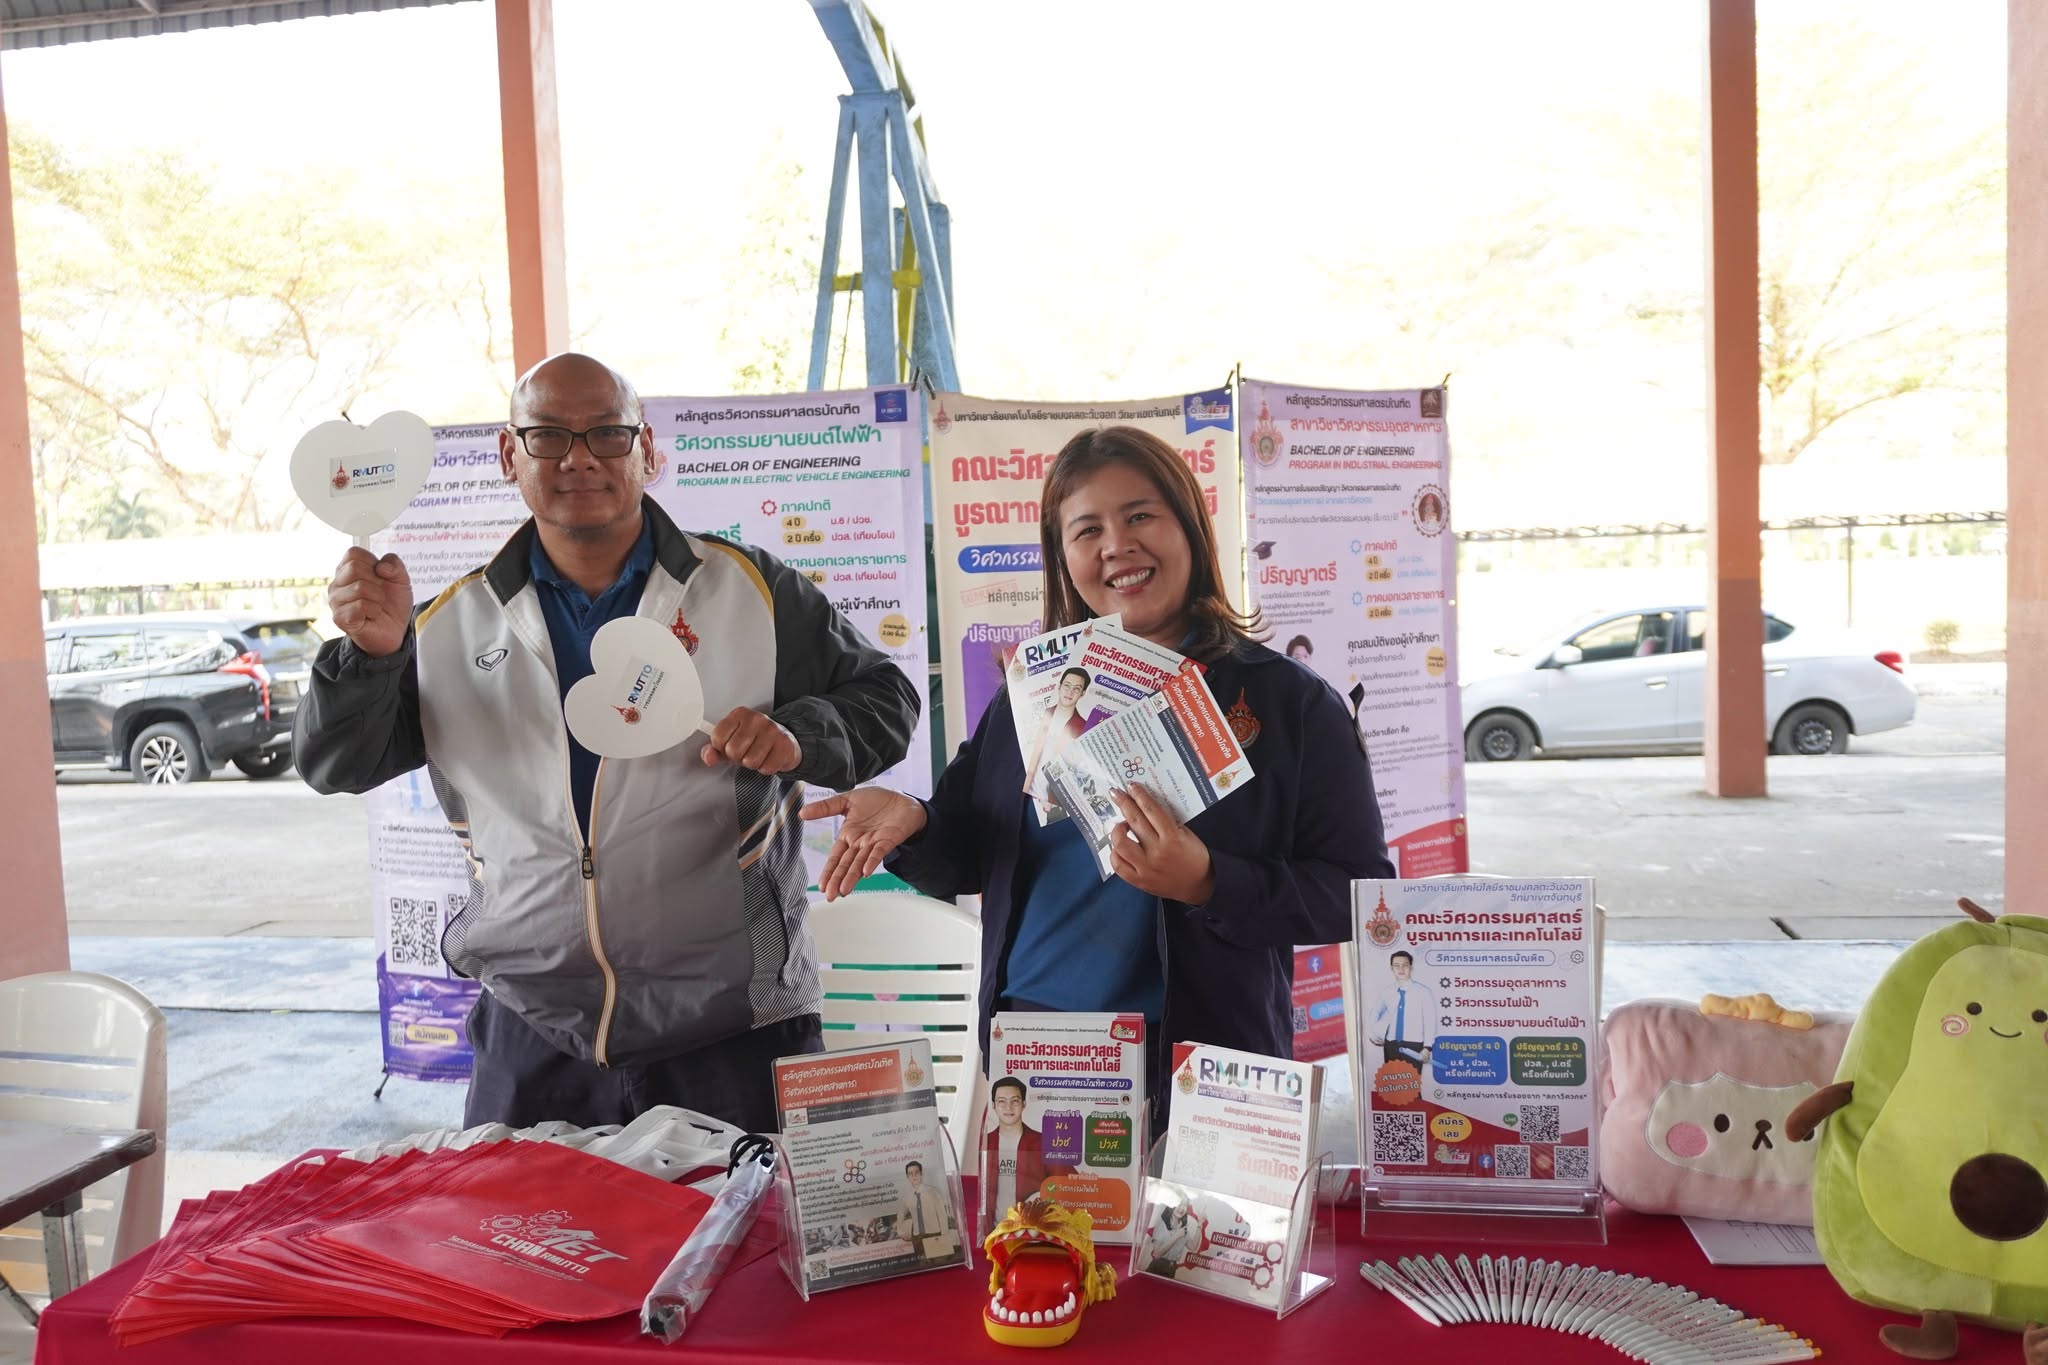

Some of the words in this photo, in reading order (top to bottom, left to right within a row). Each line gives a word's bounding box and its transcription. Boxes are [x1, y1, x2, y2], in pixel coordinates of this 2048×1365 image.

[675, 403, 860, 425] หลักสูตรวิศวกรรมศาสตรบัณฑิต
[954, 408, 1117, 422] มหาวิทยาลัยเทคโนโลยีราชมงคลตะวันออก
[1290, 417, 1442, 437] สาขาวิชาวิศวกรรมอุตสาหการ
[675, 423, 882, 452] วิศวกรรมยานยนต์ไฟฟ้า
[1290, 445, 1341, 456] BACHELOR
[1343, 445, 1357, 456] OF
[1357, 446, 1416, 456] ENGINEERING
[352, 463, 395, 478] RMUTTO
[677, 460, 749, 474] BACHELOR
[752, 460, 771, 471] OF
[772, 456, 861, 470] ENGINEERING
[1288, 460, 1332, 469] PROGRAM
[1332, 460, 1342, 469] IN
[676, 477, 729, 487] PROGRAM
[730, 476, 741, 485] IN
[742, 474, 793, 484] ELECTRIC
[796, 471, 840, 482] VEHICLE
[841, 468, 911, 480] ENGINEERING
[462, 480, 478, 490] OF
[409, 495, 449, 508] OGRAM
[450, 495, 462, 505] IN
[781, 499, 831, 513] ภาคปกติ
[786, 518, 794, 527] 4
[794, 517, 801, 527] ปี
[830, 516, 845, 525] ม.6
[852, 515, 873, 525] ปวช.
[786, 534, 794, 543] 2
[794, 533, 802, 543] ปี
[803, 532, 822, 543] ครึ่ง
[831, 532, 851, 542] ปวส.
[853, 529, 896, 541] (เทียบโอน)
[970, 548, 1043, 568] วิศวกรรม
[832, 572, 853, 582] ปวส.
[855, 570, 897, 581] (เทียบโอน)
[1260, 561, 1337, 587] ปริญญาตรี
[1025, 629, 1083, 665] RMUT
[1348, 632, 1440, 653] คุณสมบัติของผู้เข้าศึกษา
[627, 664, 653, 704] RMUTTO
[1403, 882, 1582, 893] มหาวิทยาลัยเทคโนโลยีราชมงคลตะวันออก
[1510, 892, 1582, 903] วิทยาเขตจันทบุรี
[1405, 908, 1584, 925] คณะวิศวกรรมศาสตร์
[1406, 926, 1583, 946] บูรณาการและเทคโนโลยี
[1436, 953, 1545, 963] วิศวกรรมศาสตรบัณฑิต
[1454, 975, 1567, 991] วิศวกรรมอุตสาหการ
[1455, 996, 1540, 1009] วิศวกรรมไฟฟ้า
[1455, 1015, 1586, 1029] วิศวกรรมยานยนต์ไฟฟ้า
[1006, 1041, 1122, 1058] คณะวิศวกรรมศาสตร์
[1439, 1041, 1484, 1051] ปริญญาตรี
[1486, 1042, 1492, 1050] 4
[1494, 1040, 1501, 1050] ปี
[1516, 1042, 1562, 1051] ปริญญาตรี
[1564, 1043, 1570, 1051] 3
[1572, 1041, 1579, 1051] ปี
[1006, 1057, 1121, 1075] บูรณาการและเทคโนโลยี
[1450, 1060, 1465, 1068] ม.6
[1524, 1060, 1545, 1069] ปวส.
[1551, 1059, 1572, 1068] ป.ตรี
[1200, 1058, 1303, 1098] RMUTTO
[1382, 1071, 1413, 1082] สามารถ
[1445, 1069, 1497, 1079] หรือเทียบเท่า
[1522, 1070, 1575, 1080] หรือเทียบเท่า
[1447, 1091, 1541, 1102] หลักสูตรผ่านการรับรองจาก
[1437, 1116, 1465, 1127] สมัคร
[1443, 1130, 1460, 1138] เลย
[490, 1232, 548, 1258] CHAN
[540, 1251, 591, 1275] RMUTTO
